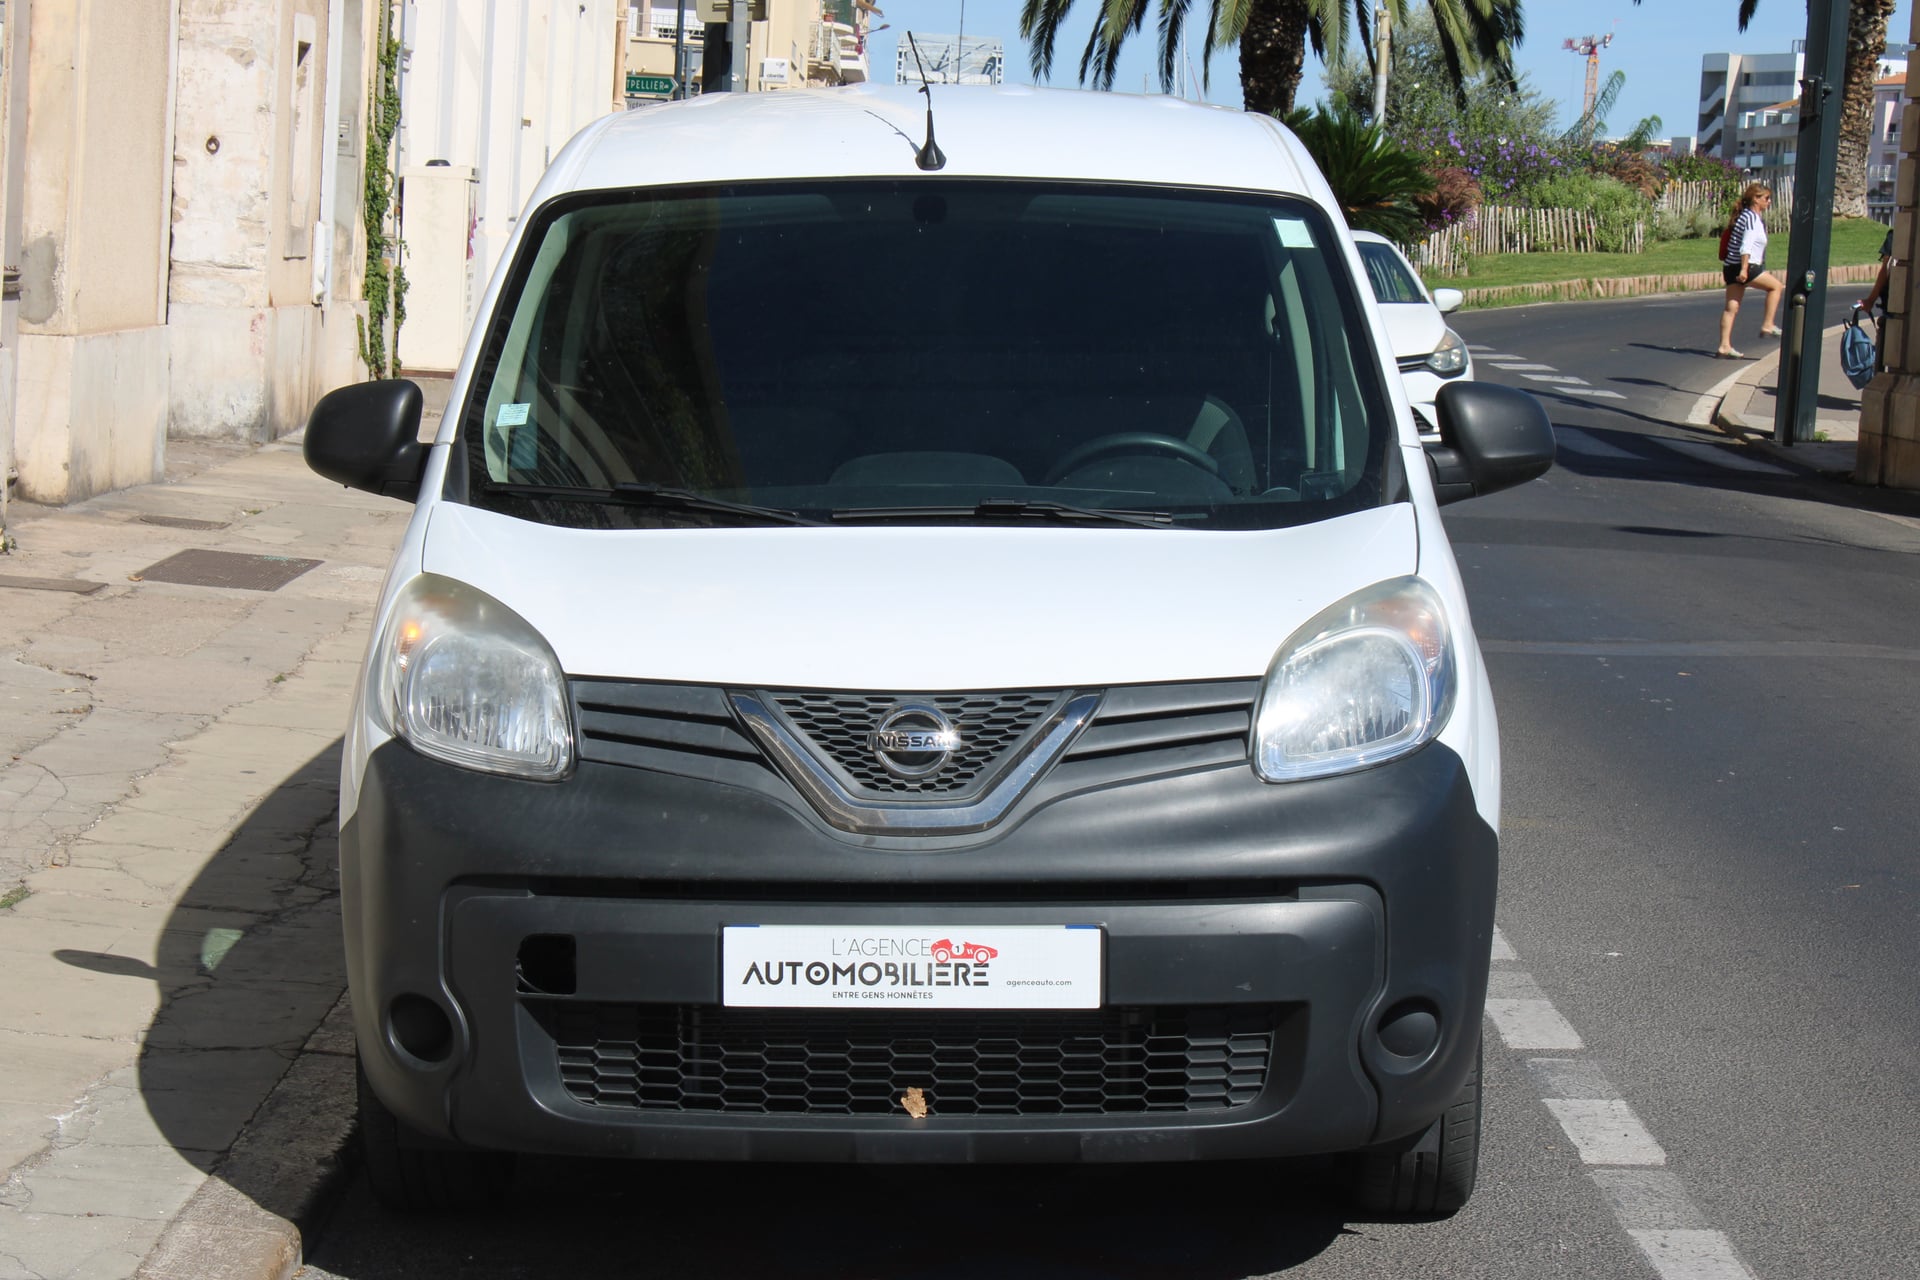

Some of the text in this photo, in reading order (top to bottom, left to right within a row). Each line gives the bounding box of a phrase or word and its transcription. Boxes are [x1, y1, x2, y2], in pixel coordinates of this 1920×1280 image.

[832, 937, 932, 957] L'AGENCE
[1006, 979, 1073, 988] agenceauto.com
[832, 989, 934, 1000] ENTRE GENS HONNÊTES
